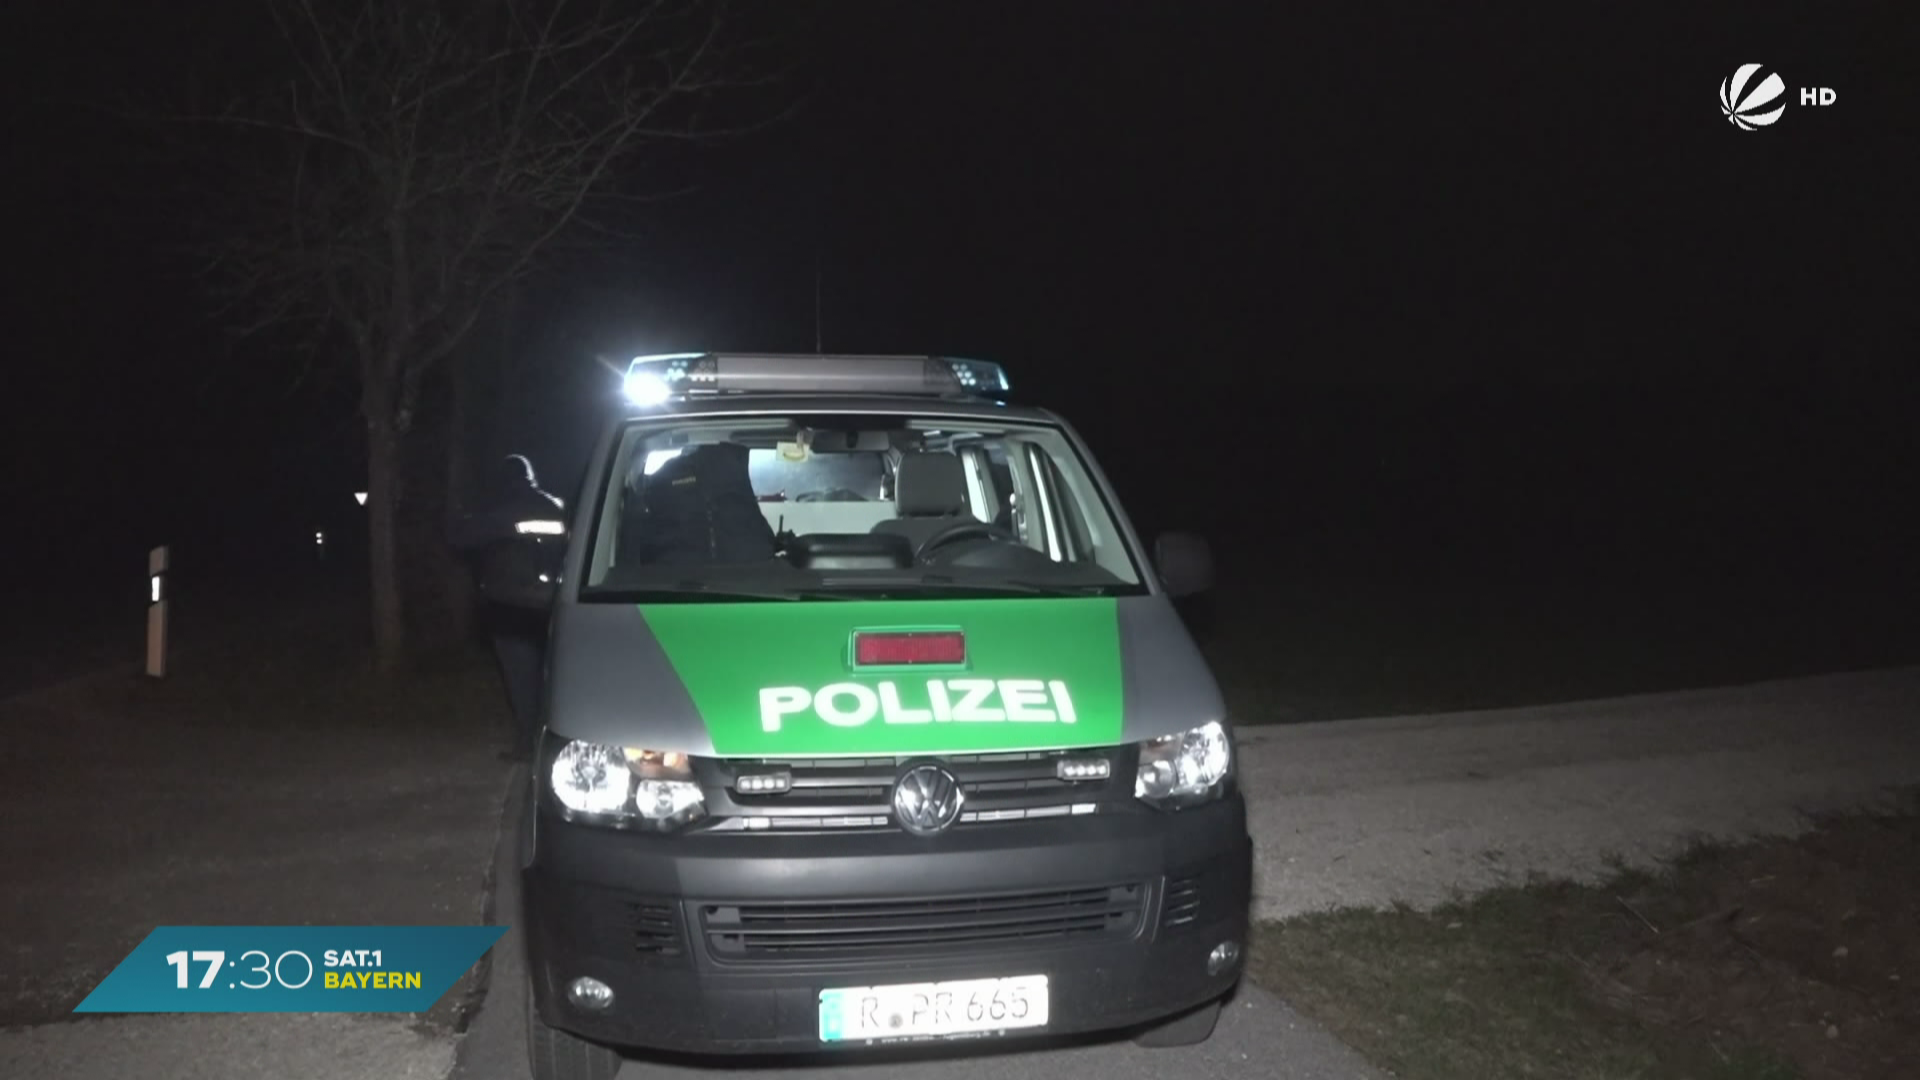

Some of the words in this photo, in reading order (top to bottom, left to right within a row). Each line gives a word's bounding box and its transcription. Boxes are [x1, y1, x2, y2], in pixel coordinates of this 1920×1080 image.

[759, 678, 1077, 732] POLIZEI
[911, 991, 953, 1025] PR
[966, 986, 1029, 1022] 665
